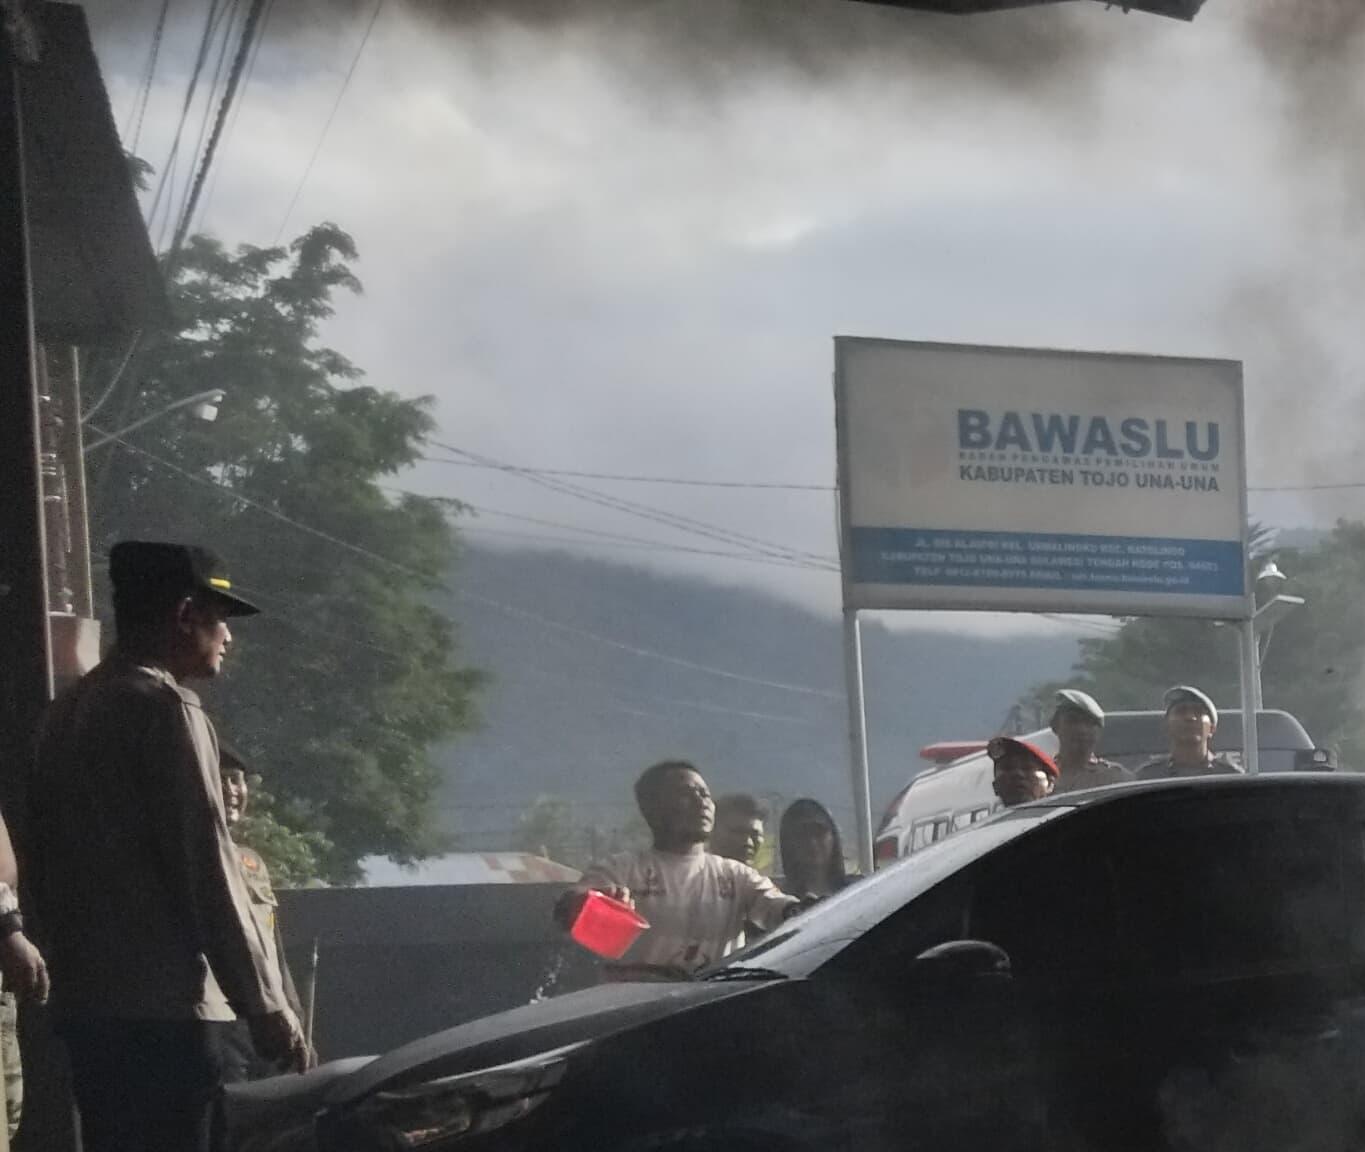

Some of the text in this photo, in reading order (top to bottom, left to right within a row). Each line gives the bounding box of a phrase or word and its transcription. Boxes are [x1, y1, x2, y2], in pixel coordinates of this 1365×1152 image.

[957, 408, 1220, 461] BAWASLU
[959, 465, 1220, 492] KABUPATEN TOJO UNA-UNA
